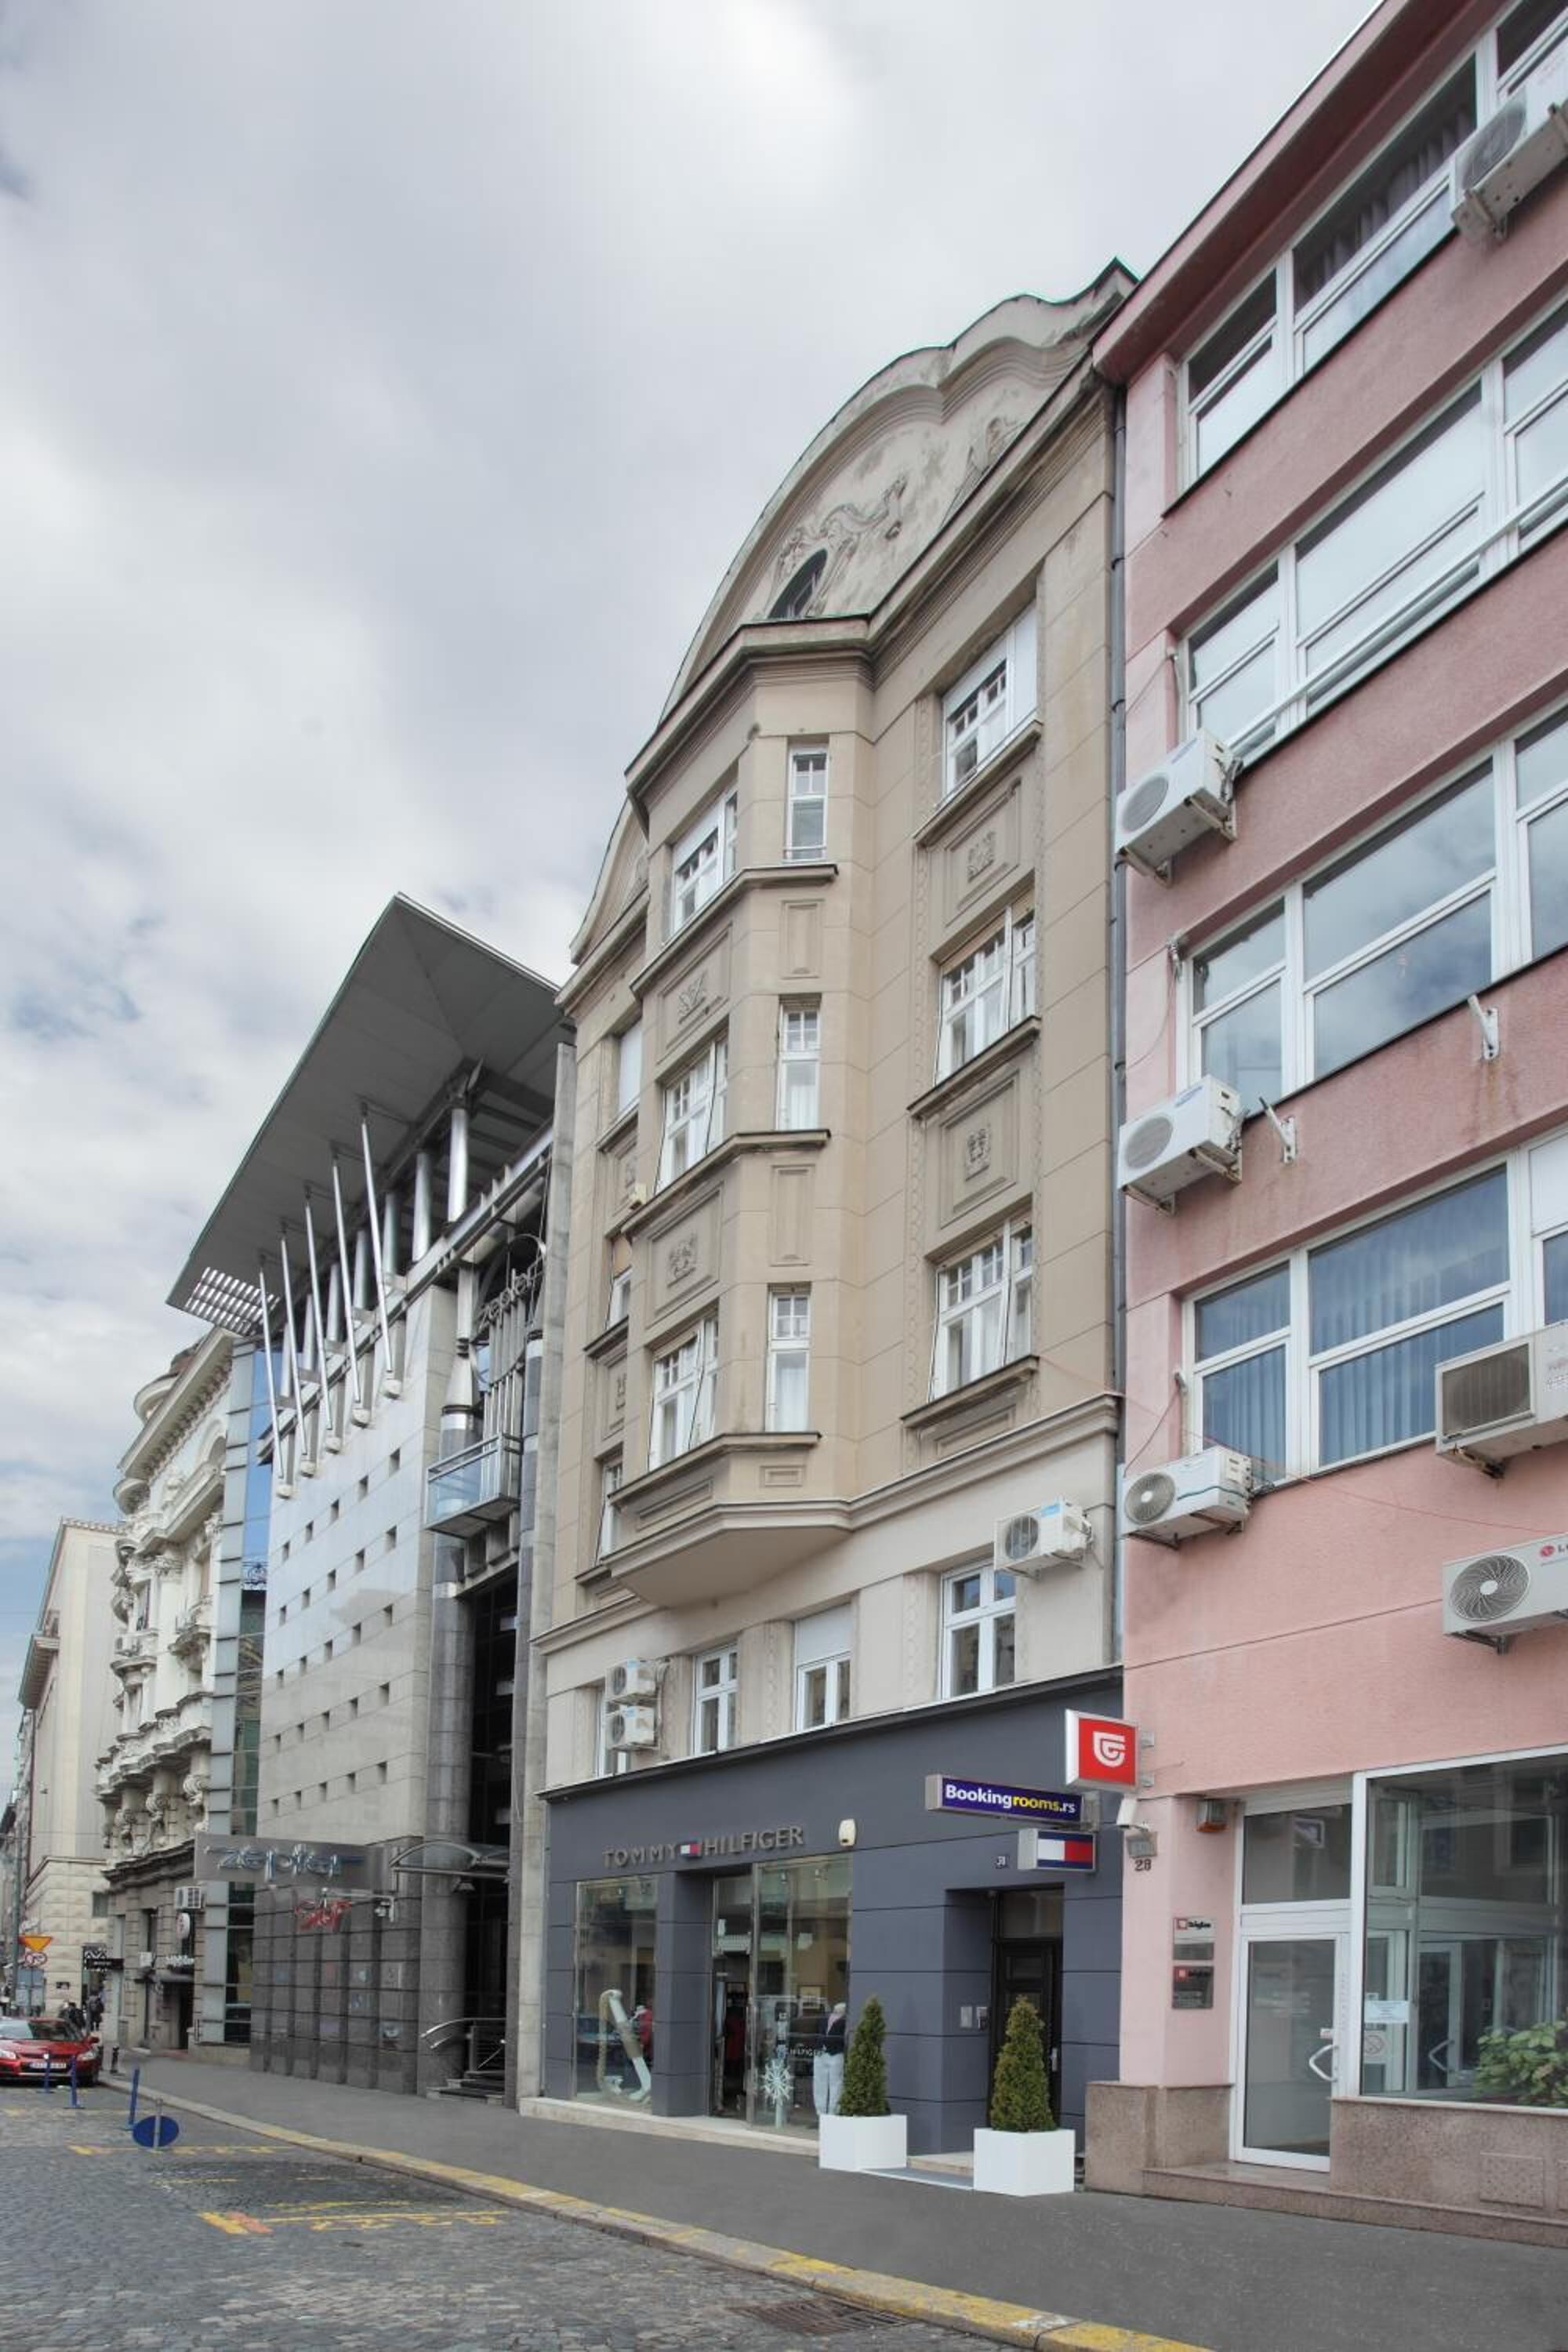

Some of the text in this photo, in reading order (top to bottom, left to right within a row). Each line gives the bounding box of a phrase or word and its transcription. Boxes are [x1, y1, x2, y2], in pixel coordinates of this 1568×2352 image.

[946, 1784, 1076, 1813] Bookingrooms.rs
[602, 1825, 804, 1868] TOMMY HILFIGER
[1135, 1858, 1152, 1872] 28
